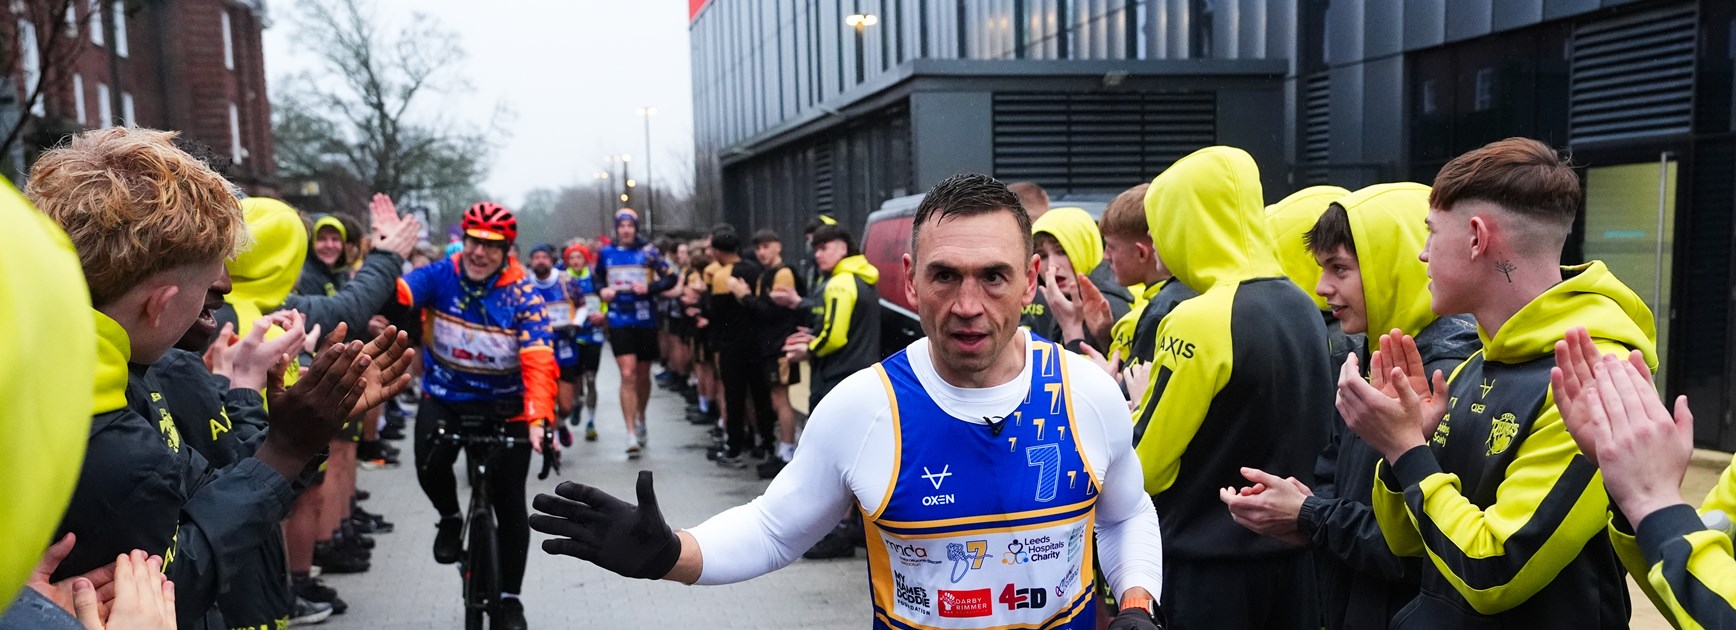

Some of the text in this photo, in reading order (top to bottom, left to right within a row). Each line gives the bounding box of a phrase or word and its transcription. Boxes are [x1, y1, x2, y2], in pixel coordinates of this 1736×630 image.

[1160, 336, 1196, 367] AXIS
[922, 494, 955, 506] OXEN
[1024, 536, 1050, 546] Leeds
[1028, 541, 1064, 554] Hospitals
[1031, 551, 1060, 562] Charity
[956, 597, 982, 605] DARBY
[956, 603, 987, 611] RIMMER
